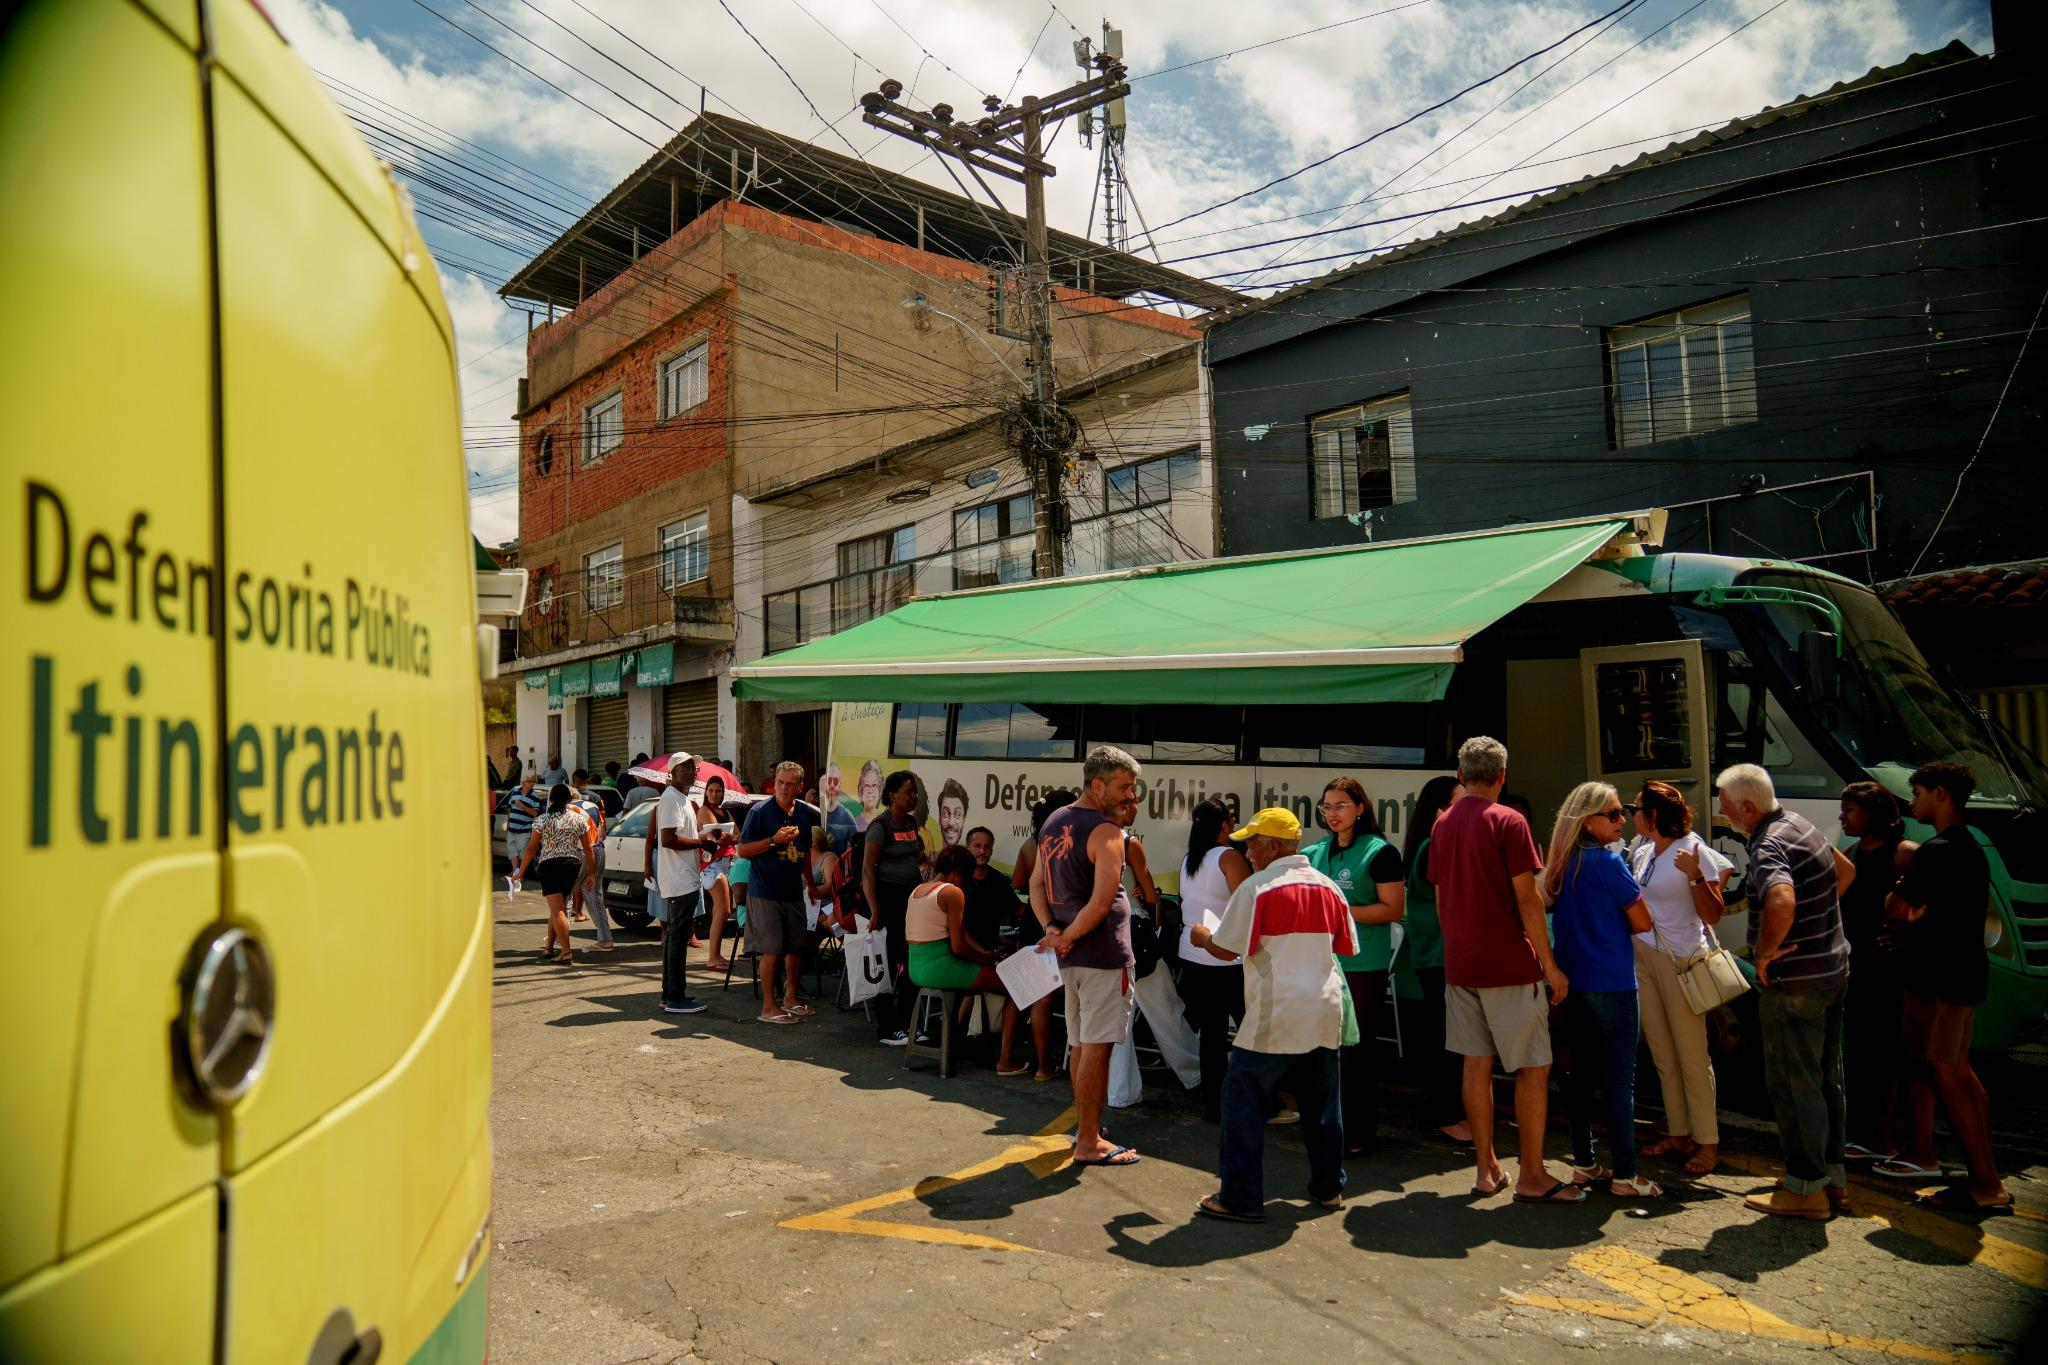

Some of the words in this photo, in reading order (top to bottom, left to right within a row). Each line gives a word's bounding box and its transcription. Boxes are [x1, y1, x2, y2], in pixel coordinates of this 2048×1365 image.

[25, 480, 334, 656] Defensoria
[346, 578, 431, 678] Pública
[29, 655, 406, 850] Itinerante
